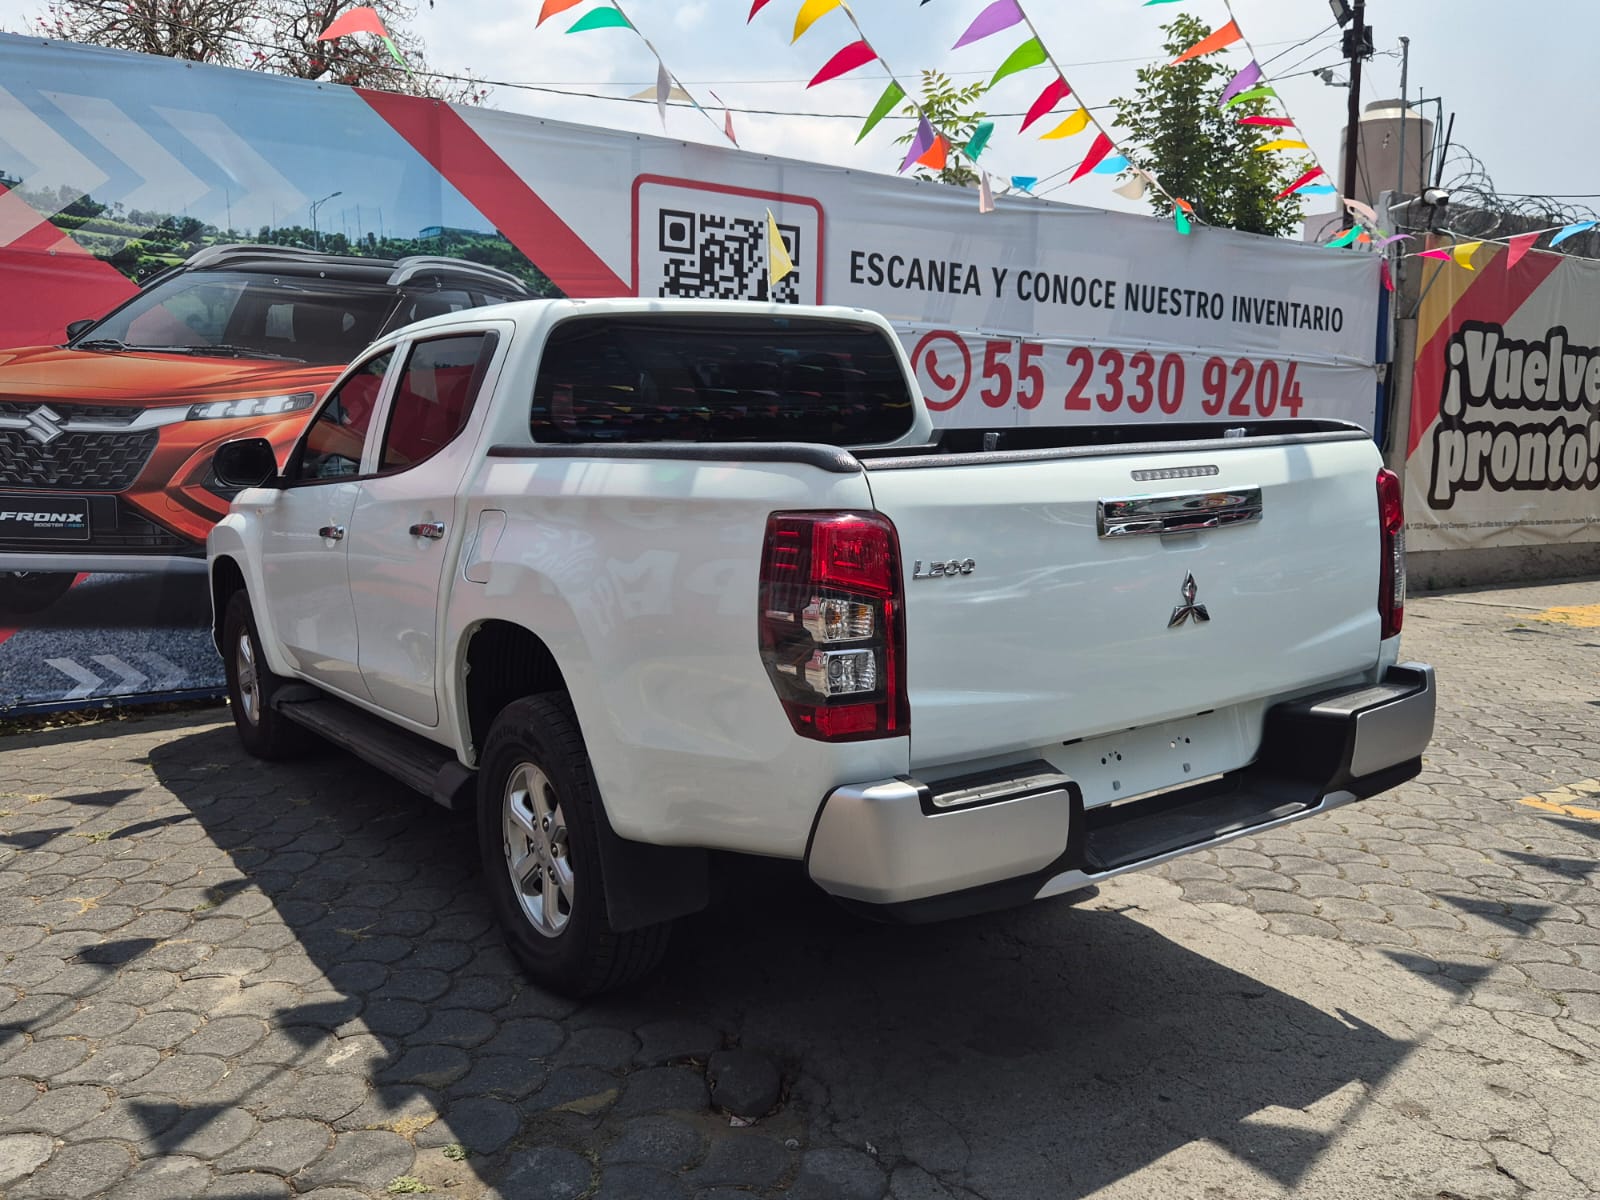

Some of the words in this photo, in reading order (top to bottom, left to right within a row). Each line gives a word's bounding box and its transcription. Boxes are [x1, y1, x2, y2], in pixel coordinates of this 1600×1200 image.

[850, 250, 981, 297] ESCANEA
[991, 267, 1008, 298] Y
[1016, 270, 1117, 310] CONOCE
[1124, 282, 1224, 321] NUESTRO
[1231, 295, 1344, 333] INVENTARIO
[980, 340, 1045, 410] 55
[1064, 346, 1186, 415] 2330
[1201, 356, 1304, 418] 9204
[1430, 419, 1600, 505] pronto!
[0, 511, 84, 523] FRONX
[912, 558, 976, 581] L200
